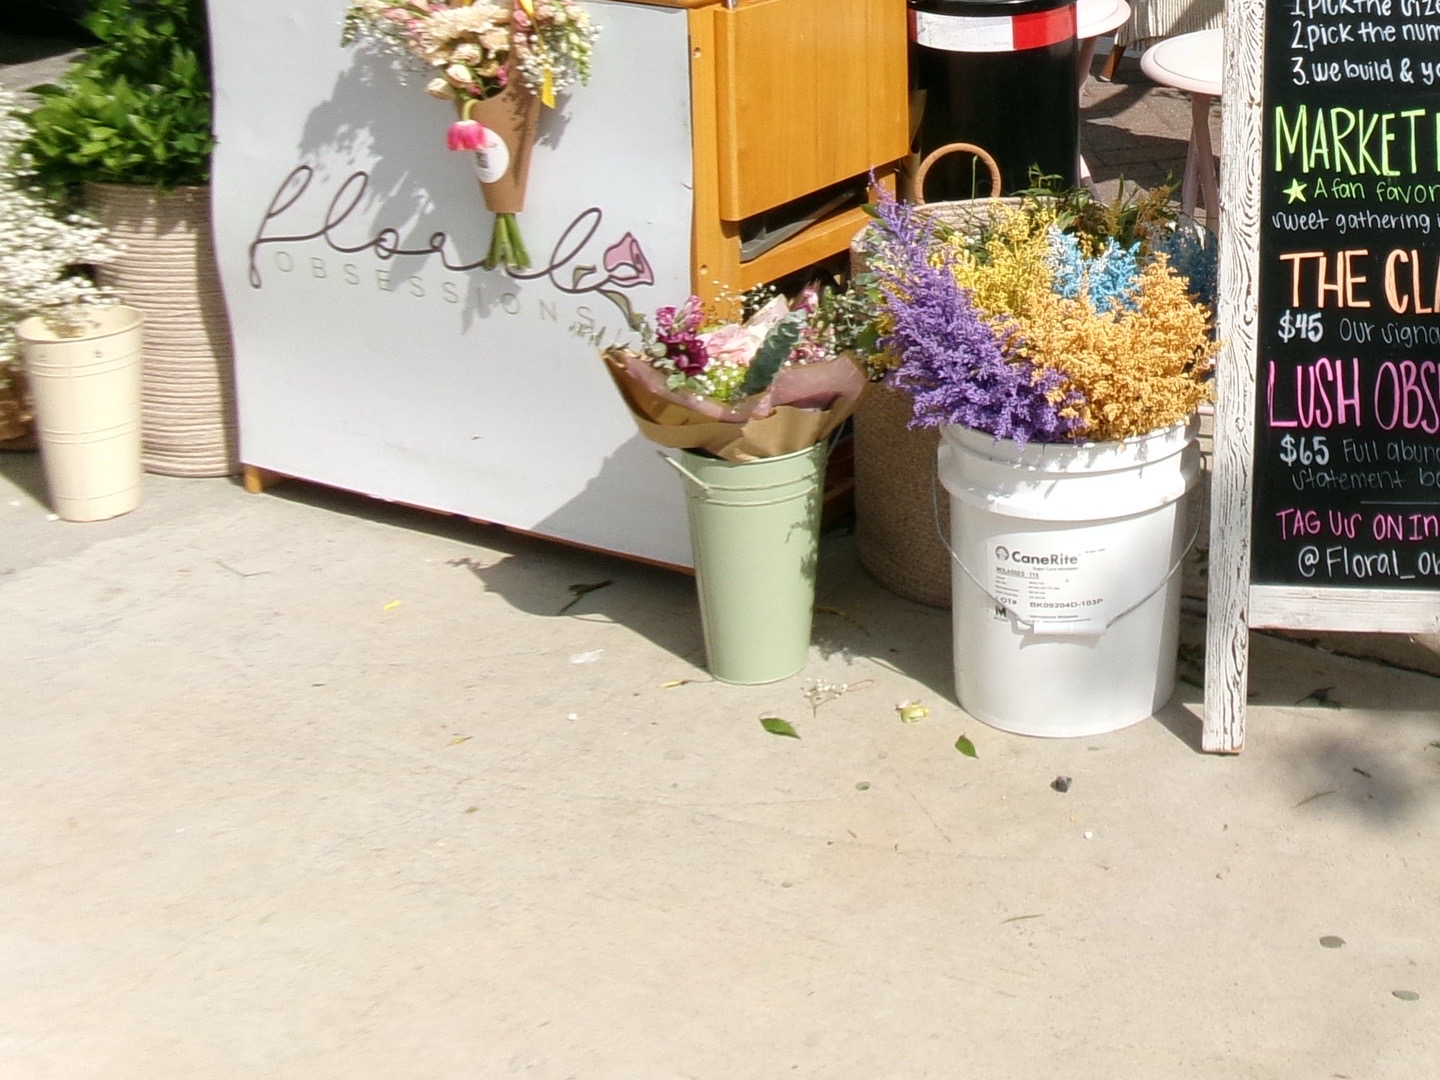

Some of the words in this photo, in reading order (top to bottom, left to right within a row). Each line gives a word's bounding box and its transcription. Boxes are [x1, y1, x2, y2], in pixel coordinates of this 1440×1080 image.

[1357, 20, 1396, 43] the
[1343, 58, 1394, 83] build
[1400, 57, 1415, 84] &
[1274, 104, 1427, 177] MARKET
[1313, 181, 1330, 200] A
[1330, 179, 1366, 201] fan
[248, 164, 603, 295] florl
[1271, 209, 1330, 232] sweet
[1335, 210, 1431, 235] gathering
[274, 250, 597, 324] OBSESSIONS
[1279, 249, 1372, 309] THE
[1277, 309, 1325, 344] $45
[1338, 317, 1376, 344] Our
[1265, 357, 1362, 429] LUSH
[1279, 433, 1331, 467] $65
[1342, 437, 1379, 463] Full
[1291, 468, 1405, 492] statement
[1276, 507, 1321, 541] TAG
[1372, 514, 1404, 541] ON
[1011, 550, 1078, 566] CaneRite
